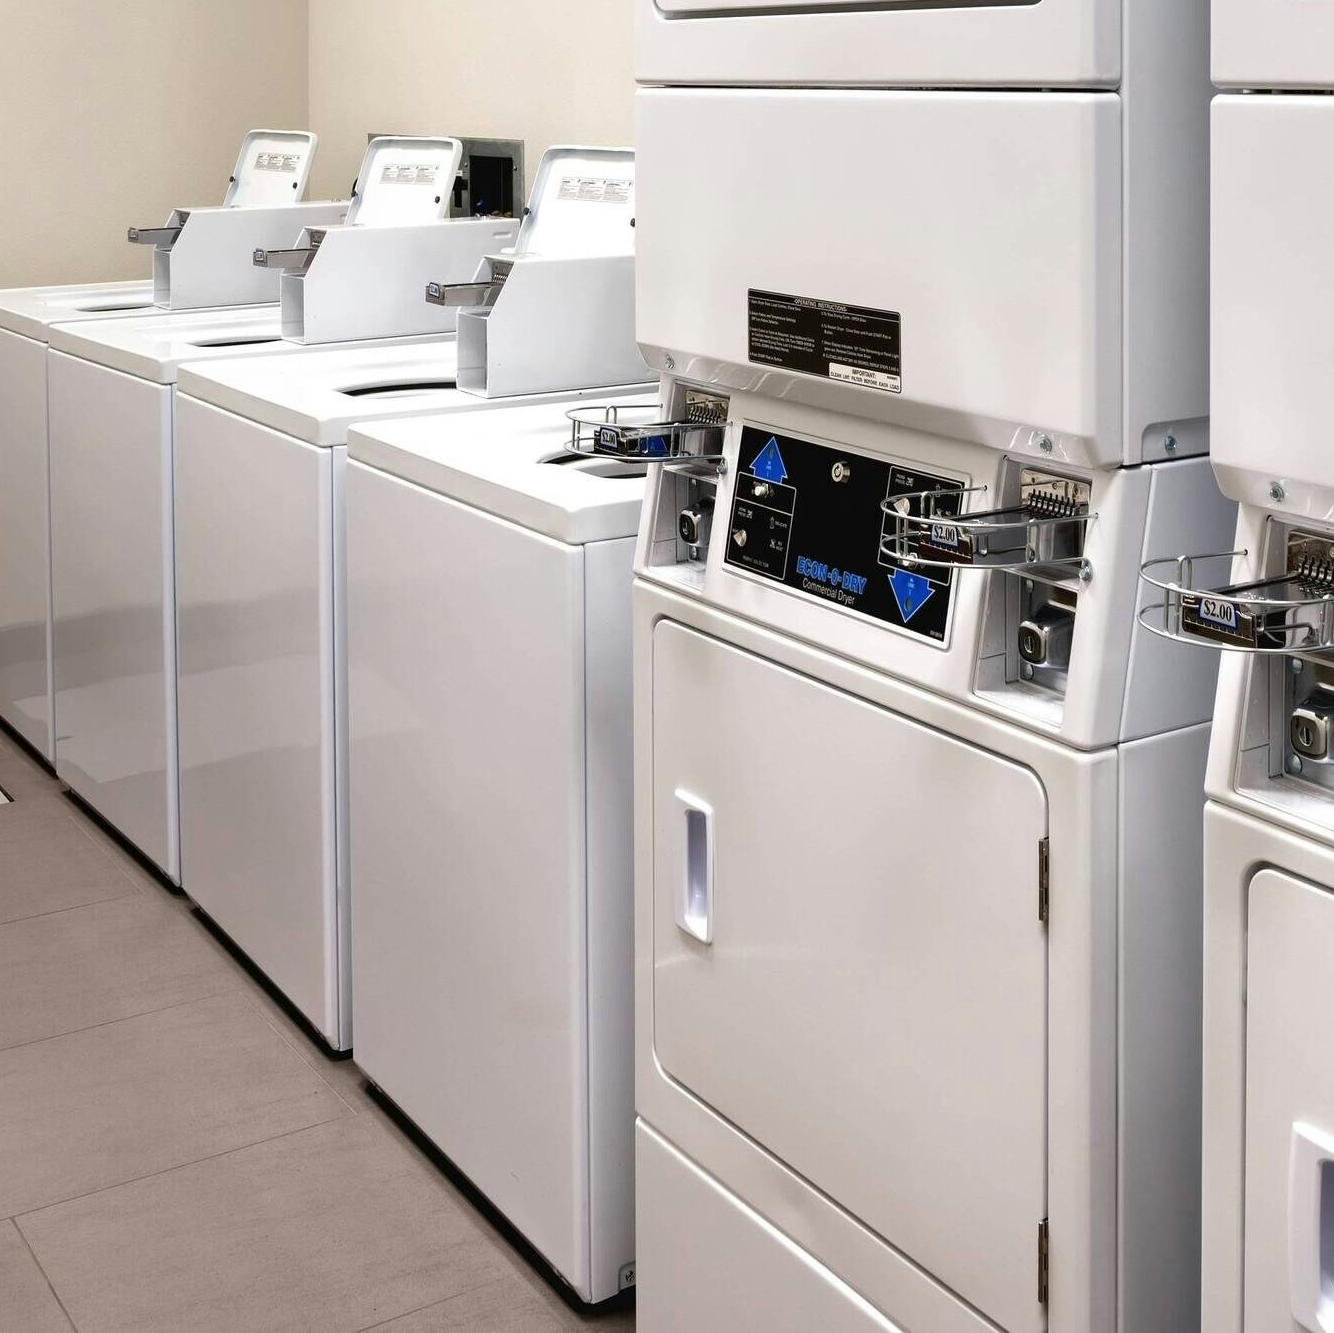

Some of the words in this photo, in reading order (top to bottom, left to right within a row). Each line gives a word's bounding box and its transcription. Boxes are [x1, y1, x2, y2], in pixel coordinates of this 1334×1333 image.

[803, 578, 837, 598] Commercial
[838, 590, 855, 605] Dryer
[1204, 600, 1231, 621] $2.00
